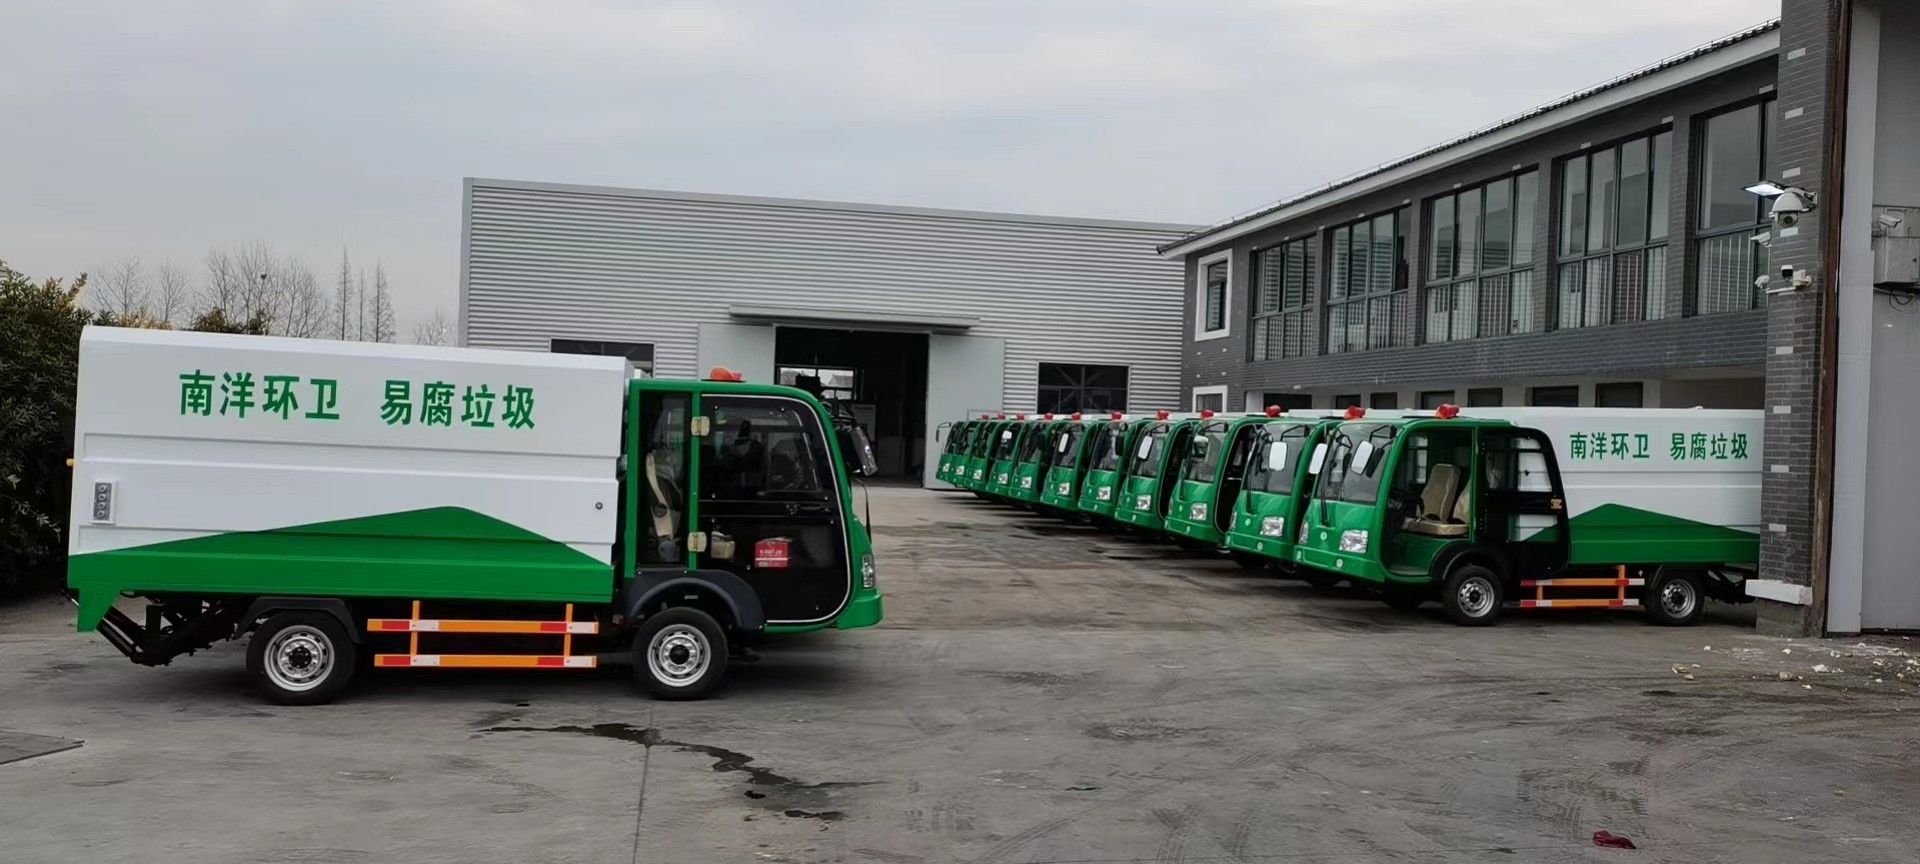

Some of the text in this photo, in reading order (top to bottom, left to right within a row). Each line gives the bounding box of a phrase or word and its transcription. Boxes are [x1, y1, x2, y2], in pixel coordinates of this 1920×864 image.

[179, 369, 535, 430] 南洋环卫 易腐垃圾
[1570, 432, 1748, 460] 南洋环卫 易腐垃圾
